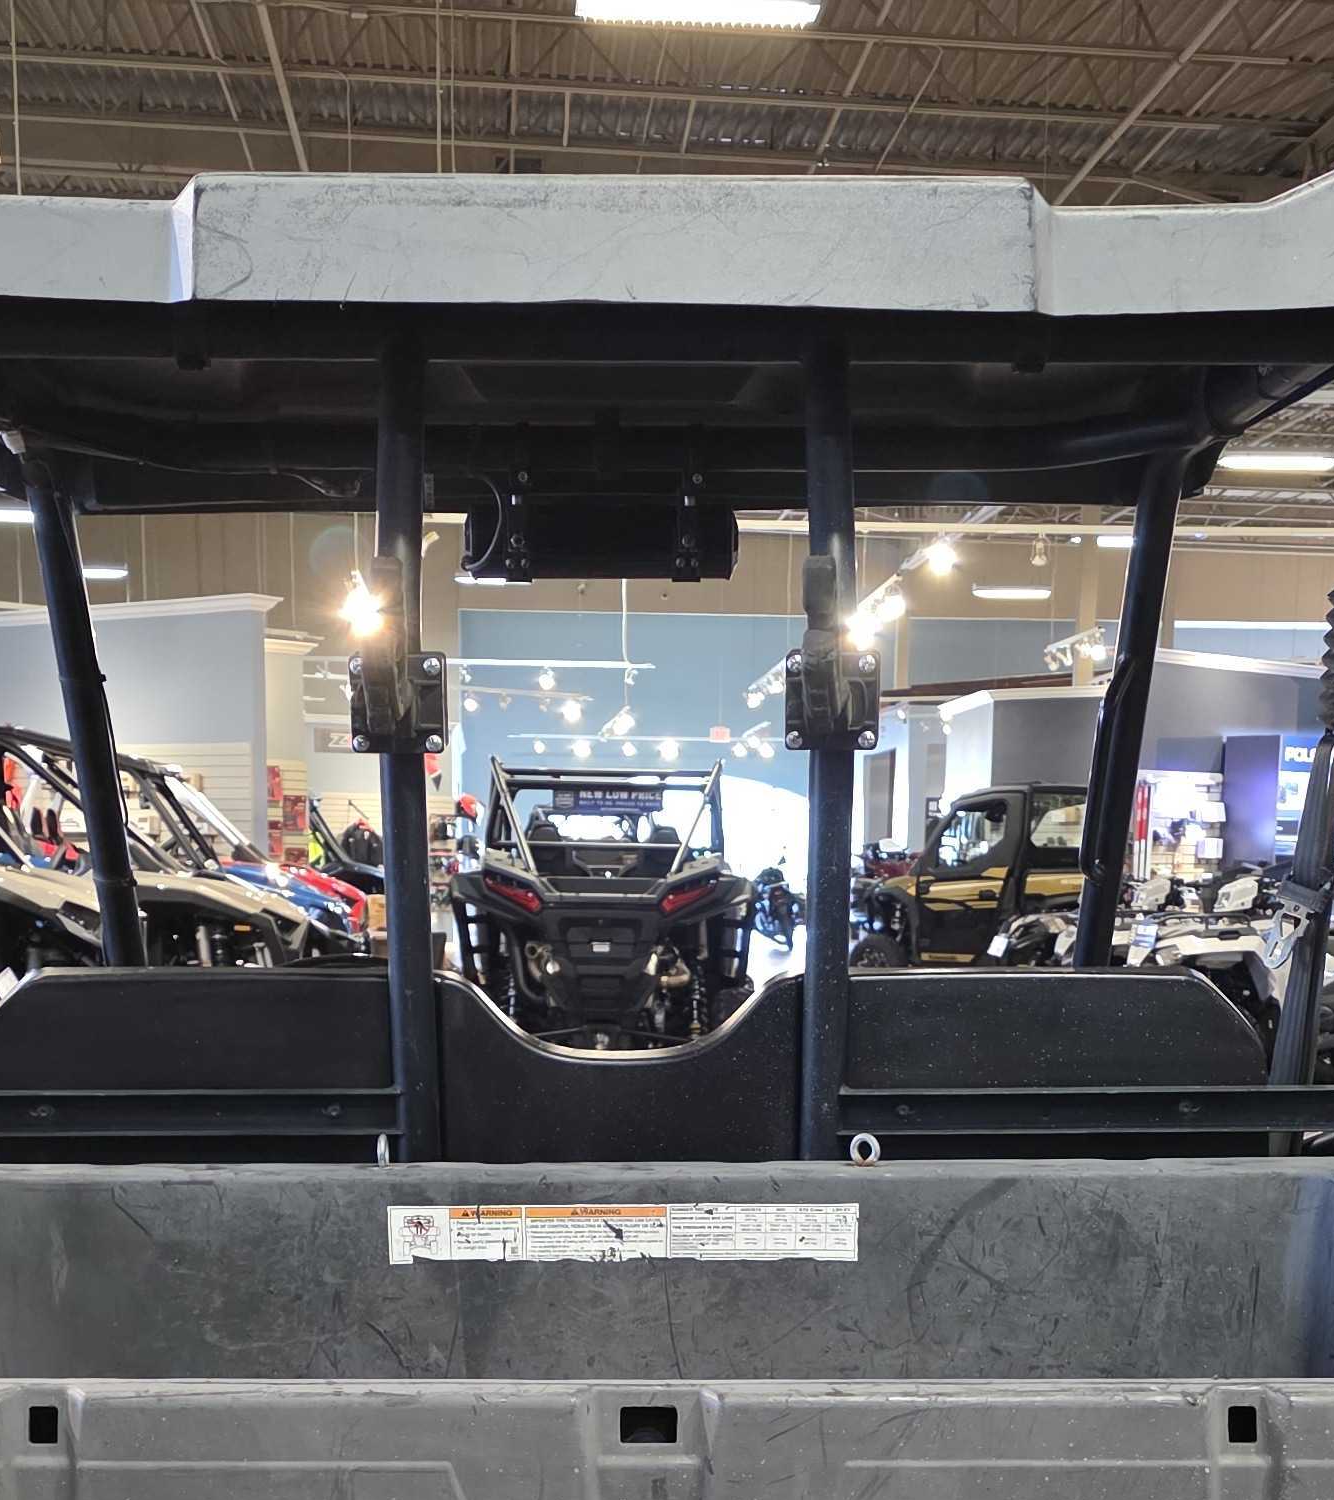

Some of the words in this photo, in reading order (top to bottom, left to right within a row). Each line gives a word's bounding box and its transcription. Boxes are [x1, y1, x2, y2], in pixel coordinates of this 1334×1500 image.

[579, 790, 604, 800] NEW
[605, 790, 629, 800] LOW
[631, 791, 662, 801] PRICE
[579, 1206, 621, 1217] WARNING
